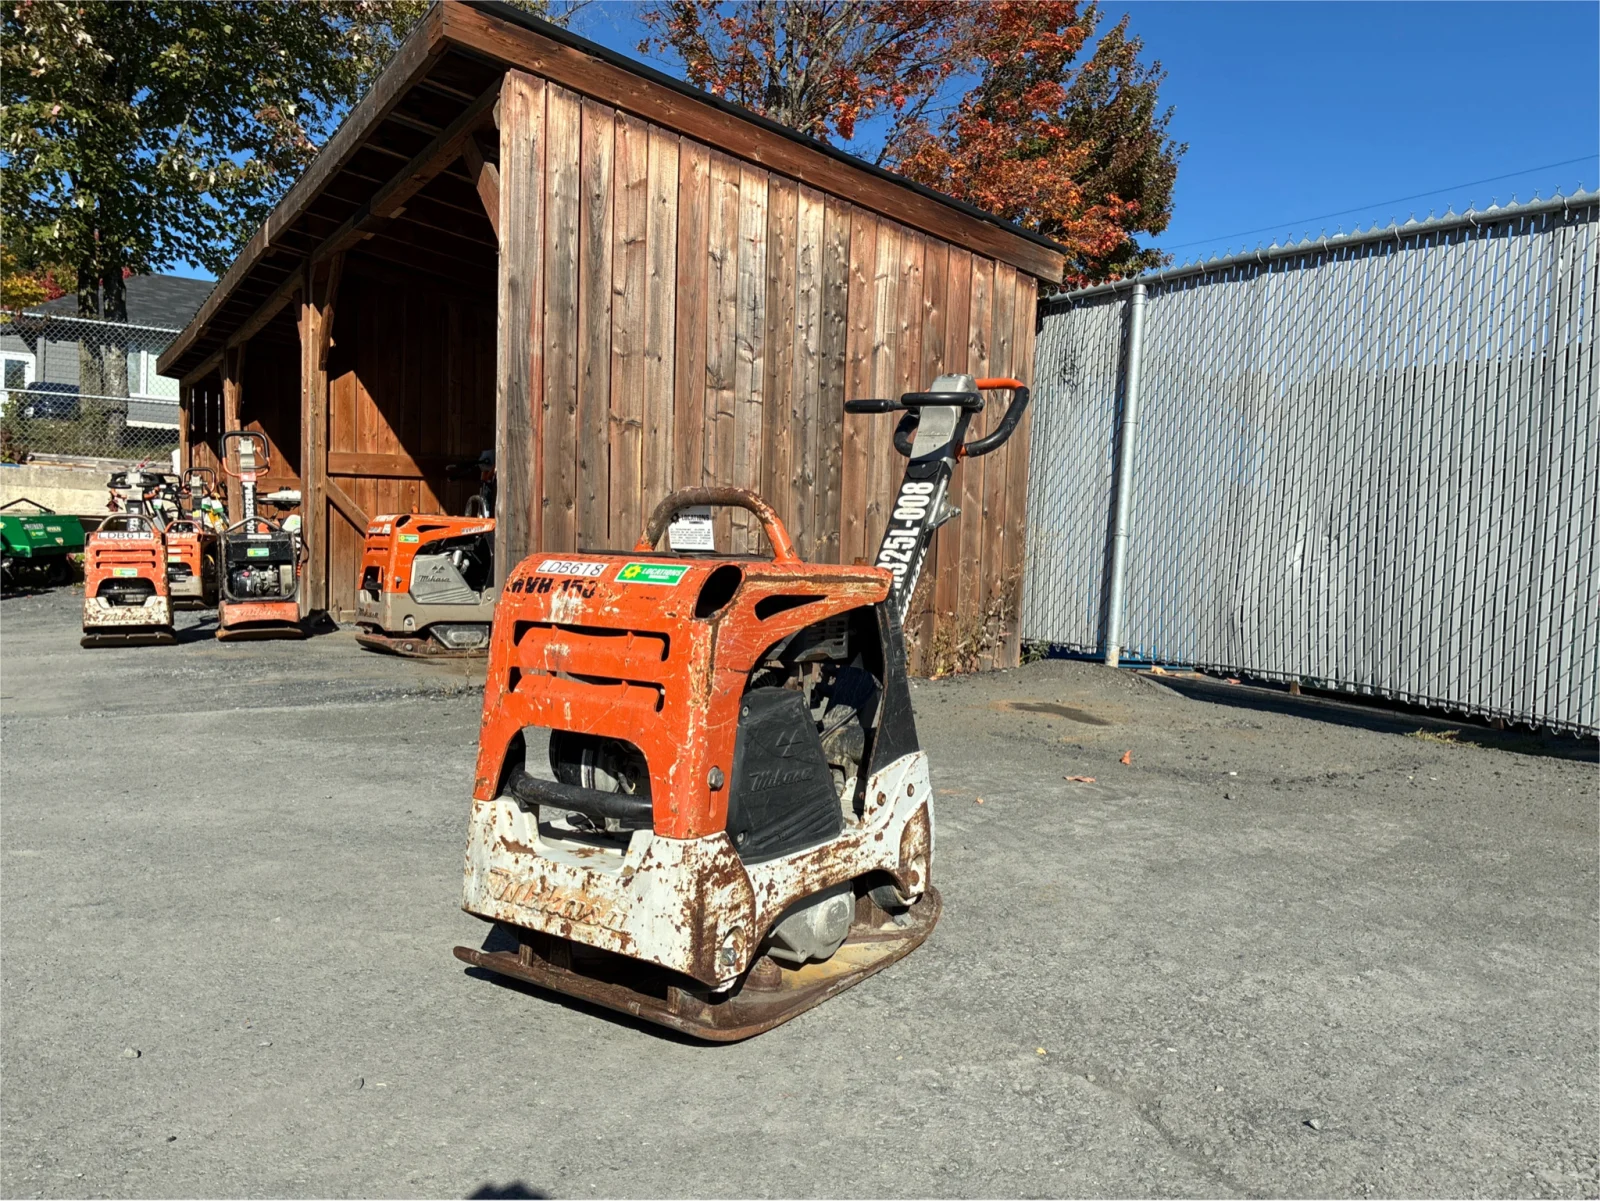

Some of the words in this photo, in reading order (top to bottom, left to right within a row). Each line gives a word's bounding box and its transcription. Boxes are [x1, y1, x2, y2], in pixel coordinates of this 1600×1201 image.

[537, 560, 605, 576] LDB618
[641, 567, 683, 577] LOCATIONS
[419, 575, 451, 583] Mikasa
